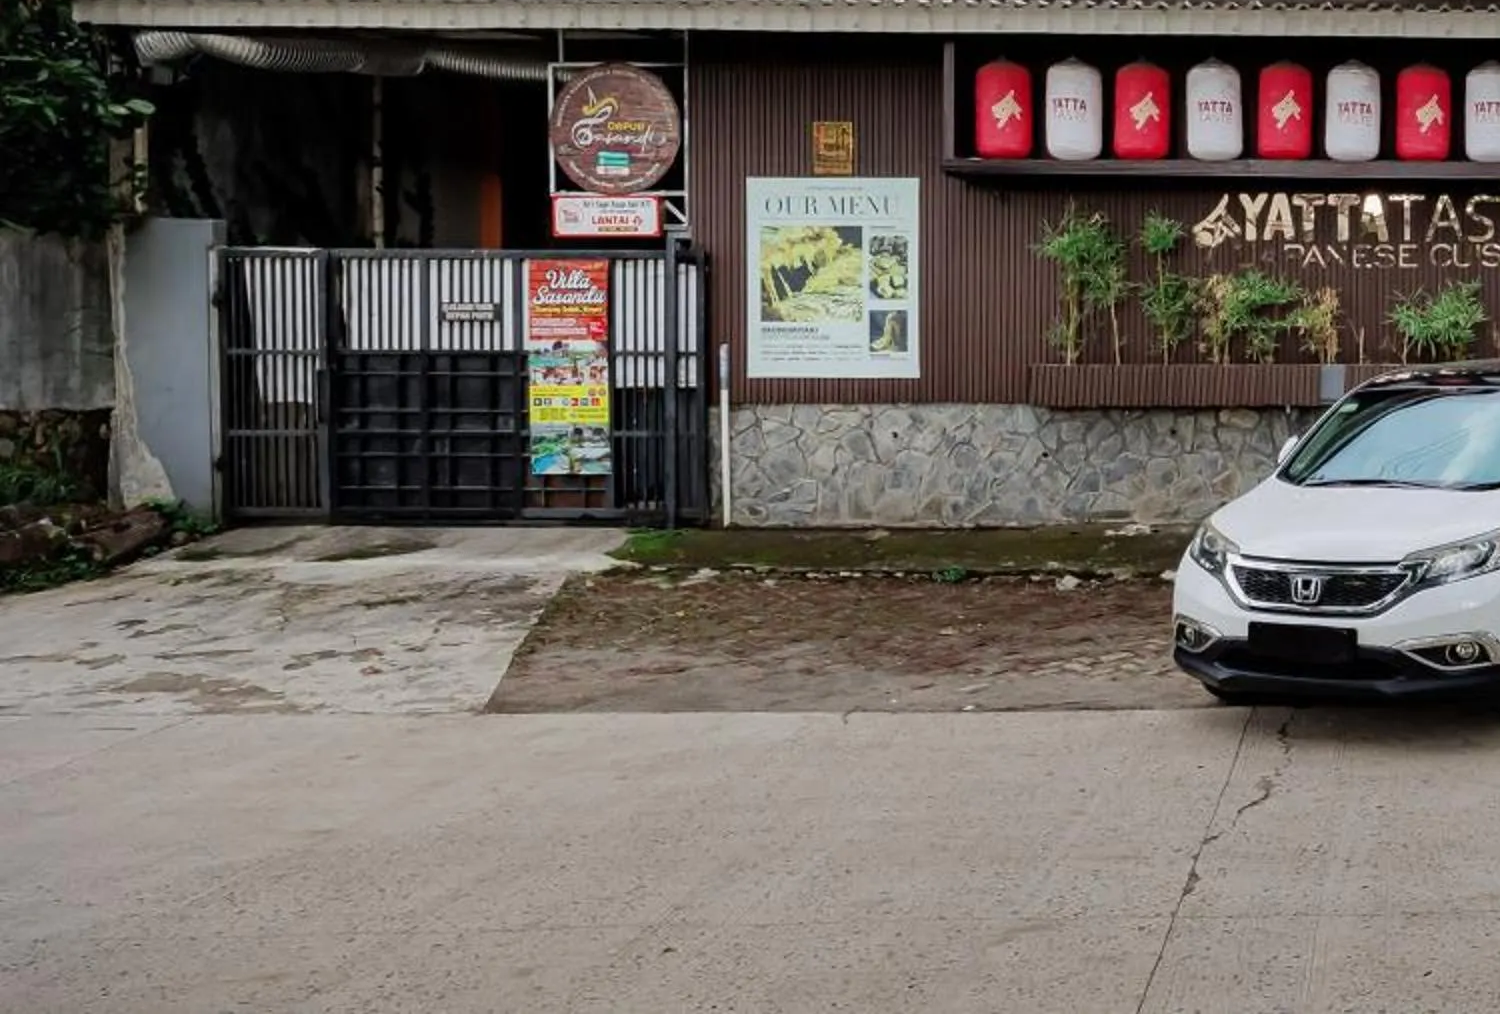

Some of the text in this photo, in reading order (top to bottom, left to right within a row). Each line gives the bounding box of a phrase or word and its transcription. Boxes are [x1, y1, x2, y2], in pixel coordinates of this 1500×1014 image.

[1052, 97, 1087, 112] YATTA
[1198, 100, 1233, 113] YATTA
[1337, 102, 1373, 115] YATTA
[765, 195, 899, 215] OUR MENU
[545, 269, 591, 289] Villa
